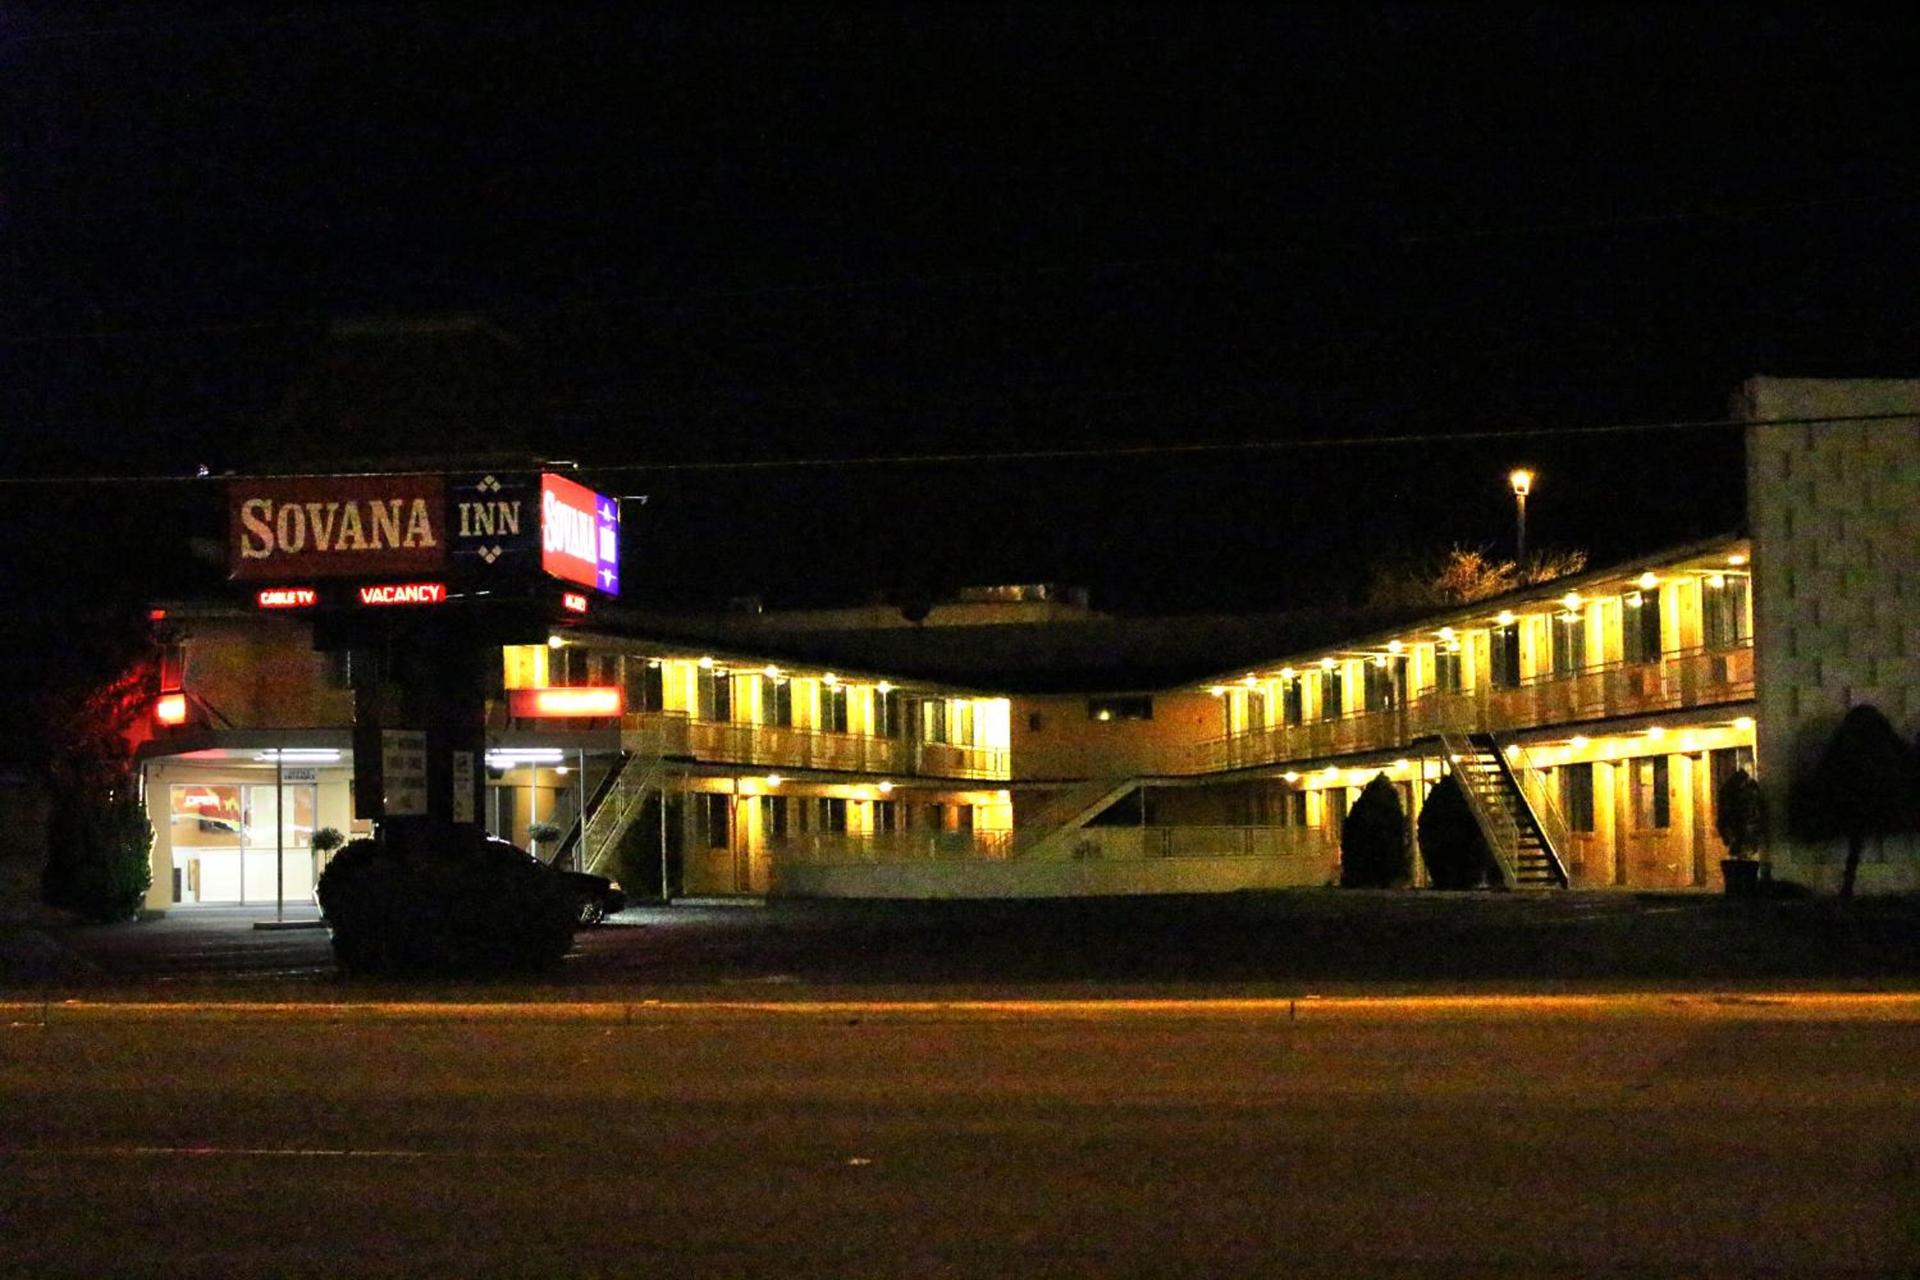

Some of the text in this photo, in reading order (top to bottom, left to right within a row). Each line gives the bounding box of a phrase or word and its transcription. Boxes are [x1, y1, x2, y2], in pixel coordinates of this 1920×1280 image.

[240, 497, 522, 560] SOVANA INN
[360, 585, 441, 603] VACANCY
